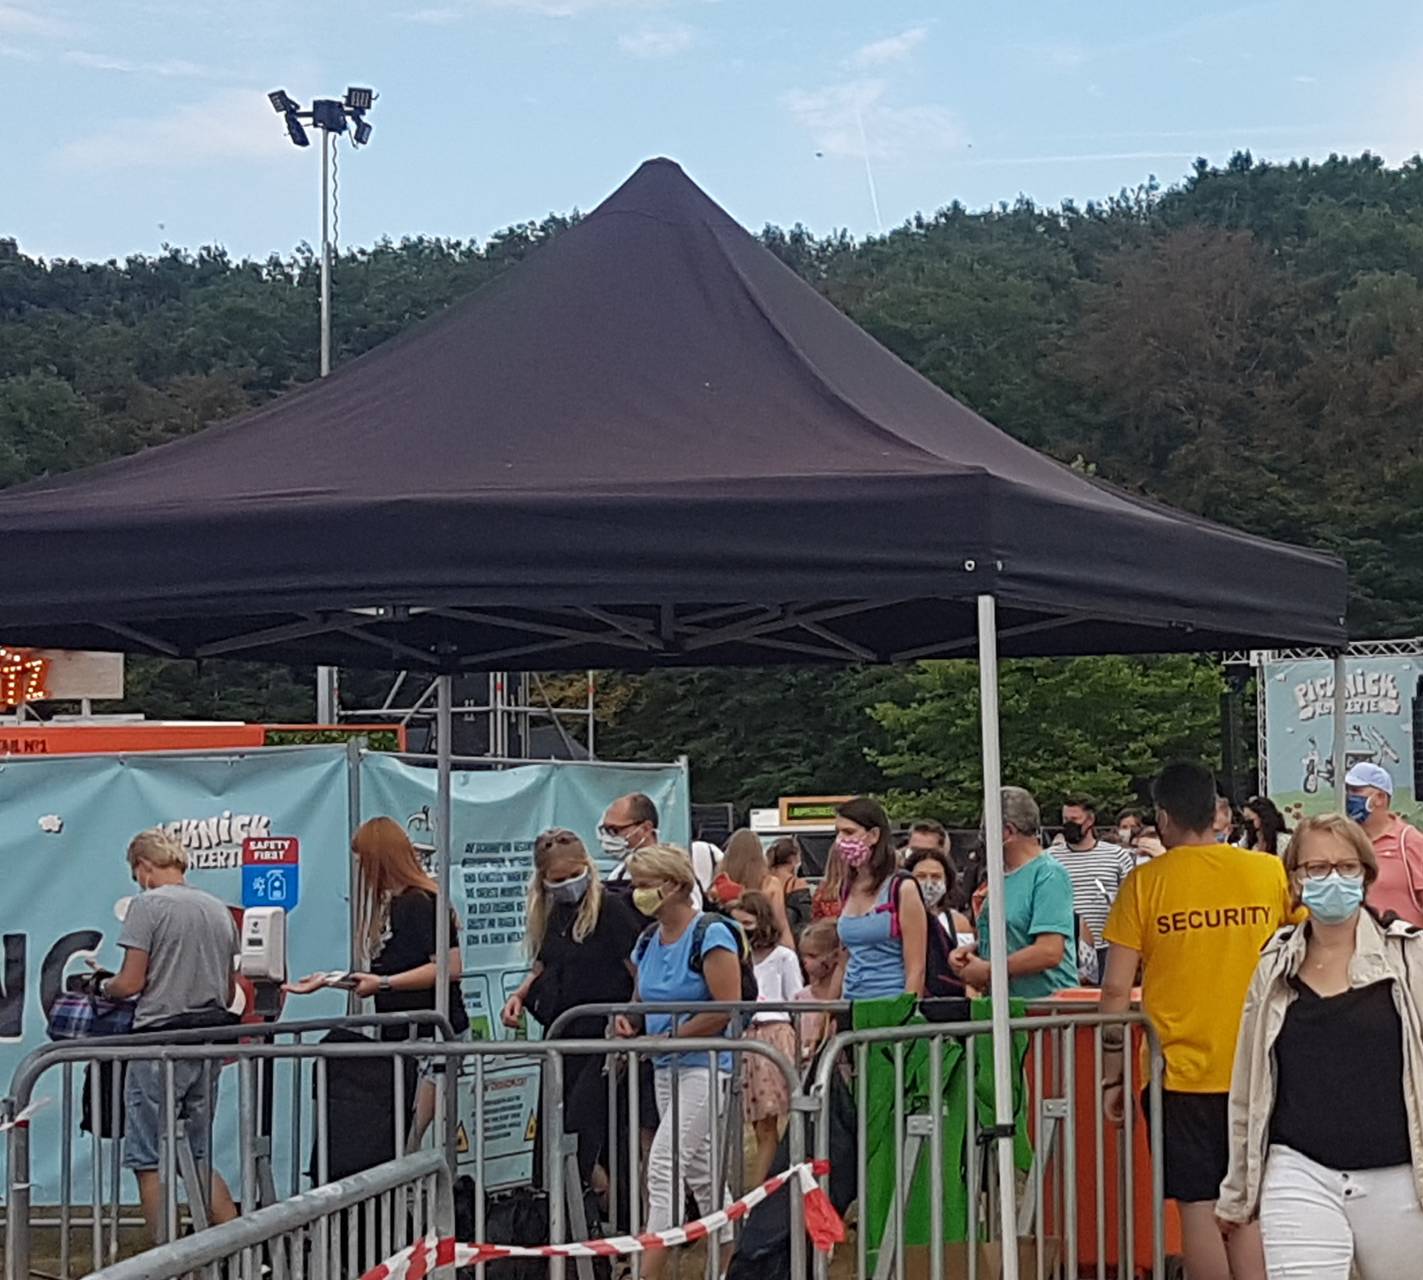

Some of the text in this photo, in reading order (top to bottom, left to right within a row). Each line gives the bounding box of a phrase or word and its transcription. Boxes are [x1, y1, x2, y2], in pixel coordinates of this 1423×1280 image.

[249, 840, 290, 851] SAFETY
[253, 850, 285, 861] FIRST
[1156, 906, 1271, 935] SECURITY
